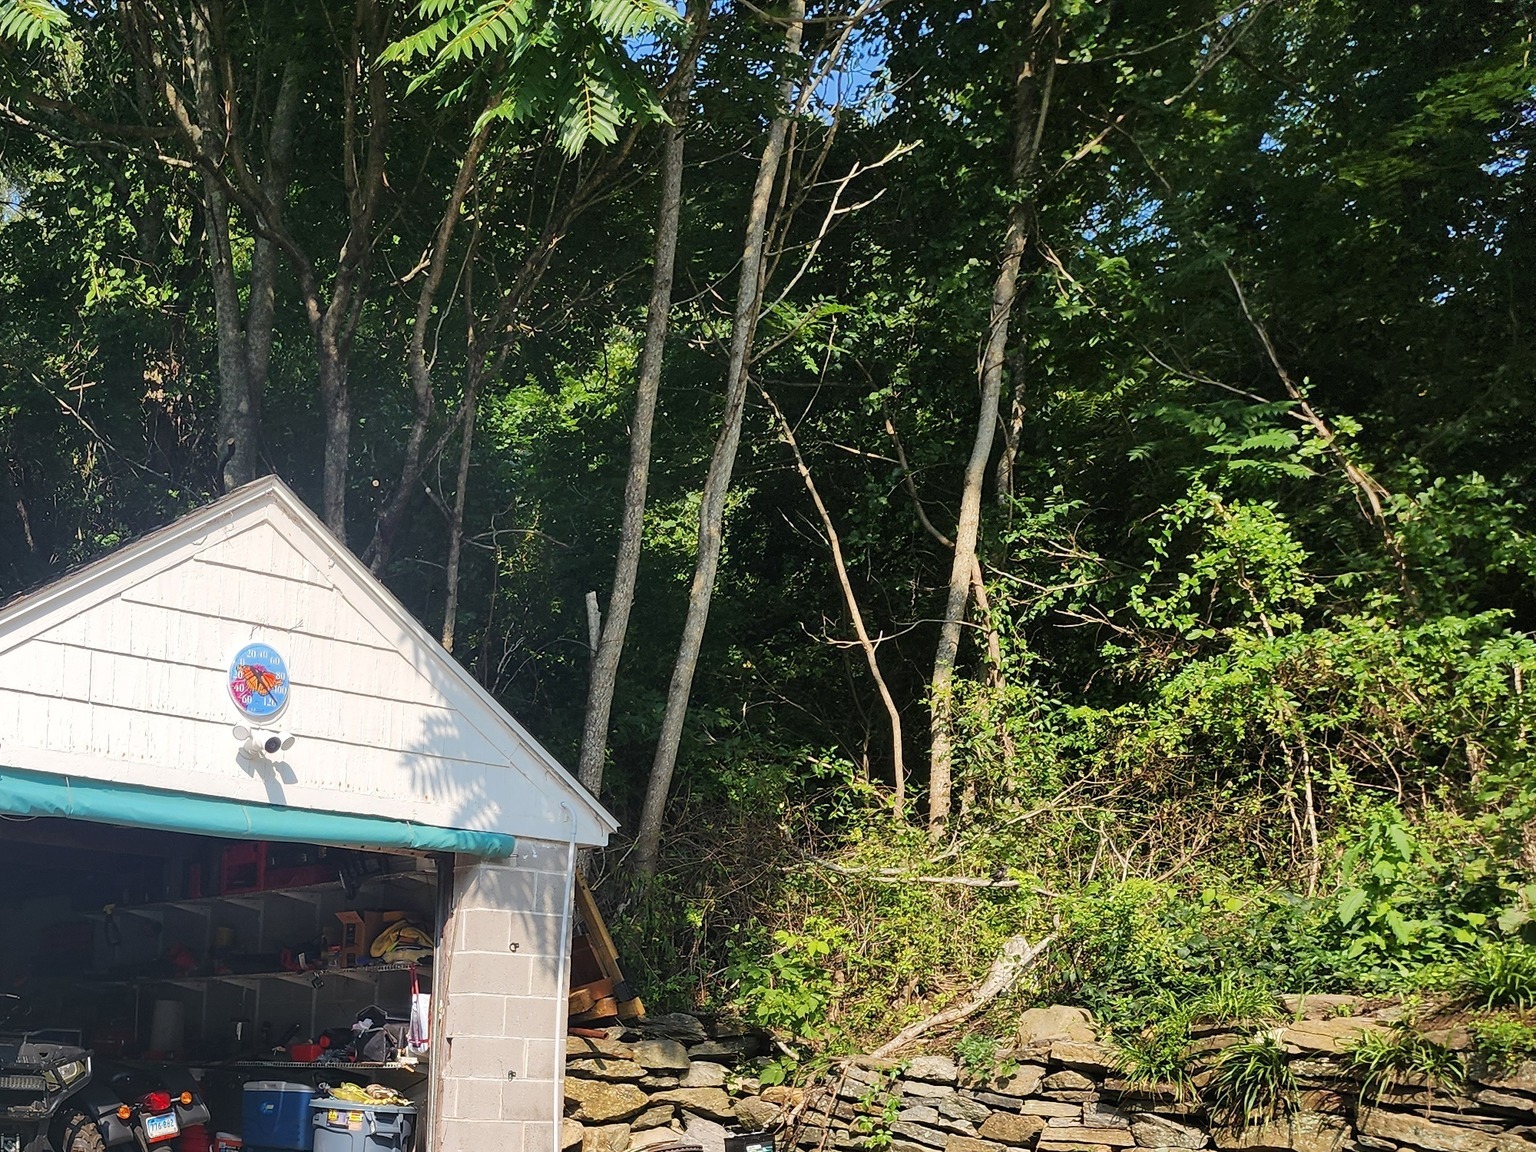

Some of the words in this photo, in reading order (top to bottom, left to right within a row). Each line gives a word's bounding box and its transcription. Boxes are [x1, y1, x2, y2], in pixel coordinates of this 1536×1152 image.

[247, 650, 256, 658] 20
[259, 650, 268, 658] 40
[270, 657, 280, 665] 60
[234, 683, 245, 692] 40
[274, 686, 286, 694] 100
[241, 695, 252, 704] 60
[263, 697, 277, 707] 120
